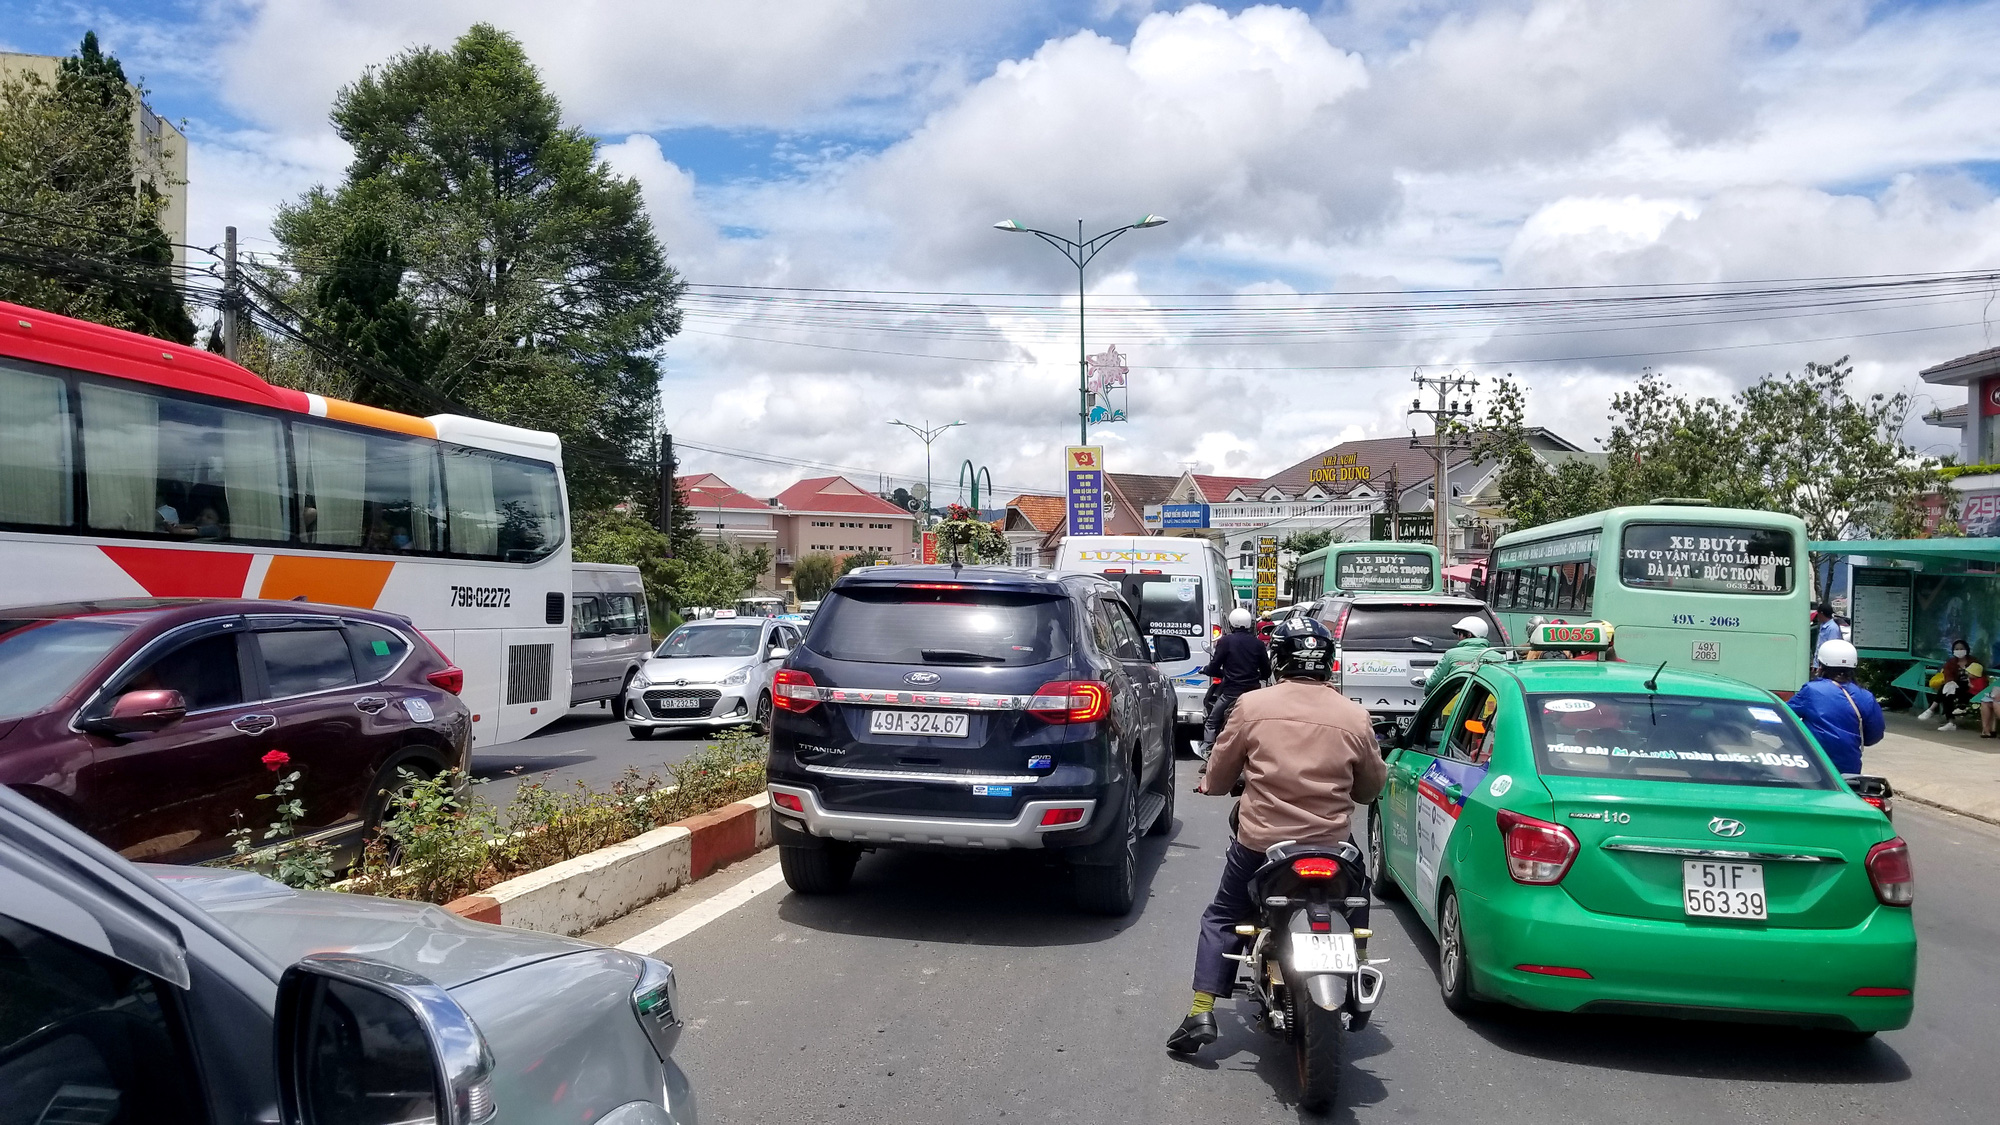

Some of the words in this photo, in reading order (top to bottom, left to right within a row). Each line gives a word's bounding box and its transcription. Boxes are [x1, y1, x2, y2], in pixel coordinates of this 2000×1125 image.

[1309, 468, 1337, 482] LONG
[1340, 466, 1370, 481] DUNG
[1968, 498, 2000, 520] 29
[1400, 523, 1416, 536] LÂM
[1419, 522, 1433, 536] HẢI
[1670, 536, 1694, 550] XE
[1699, 536, 1749, 552] BUÝT
[1080, 551, 1189, 562] LUXURY
[1258, 556, 1276, 569] LONG
[1375, 555, 1406, 564] BUÝT
[1626, 549, 1647, 559] CTY
[1649, 550, 1663, 560] CP
[1666, 549, 1688, 563] VẬN
[1690, 550, 1709, 562] TẢI
[1712, 550, 1734, 563] ÔTO
[1736, 552, 1759, 565] LÂM
[1760, 551, 1791, 567] ĐỒNG
[1342, 564, 1355, 573] ĐÀ
[1356, 566, 1374, 574] LẠT
[1380, 564, 1398, 574] ĐỨC
[1400, 566, 1430, 575] TRỌNG
[1648, 560, 1665, 576] ĐÀ
[1667, 564, 1690, 580] LẠT
[1704, 563, 1728, 580] ĐỨC
[1730, 567, 1769, 584] TRỌNG
[1258, 572, 1276, 584] DUNG
[1726, 582, 1782, 592] 0633.511107
[1672, 614, 1695, 625] 49X
[1709, 616, 1741, 628] 2063
[1548, 628, 1595, 642] 1055
[1698, 642, 1715, 651] 49X
[1695, 651, 1717, 660] 2063
[833, 691, 1008, 707] EVEREST
[874, 712, 965, 734] 49A-324.67
[798, 744, 846, 755] TITANIUM
[1548, 743, 1583, 754] TỔNG
[1676, 751, 1714, 761] TOÀN
[1715, 753, 1751, 762] QUỐC
[1604, 810, 1630, 824] i10
[1703, 865, 1744, 889] 51F
[1688, 889, 1763, 915] 563.39
[1305, 936, 1344, 951] 9-H1
